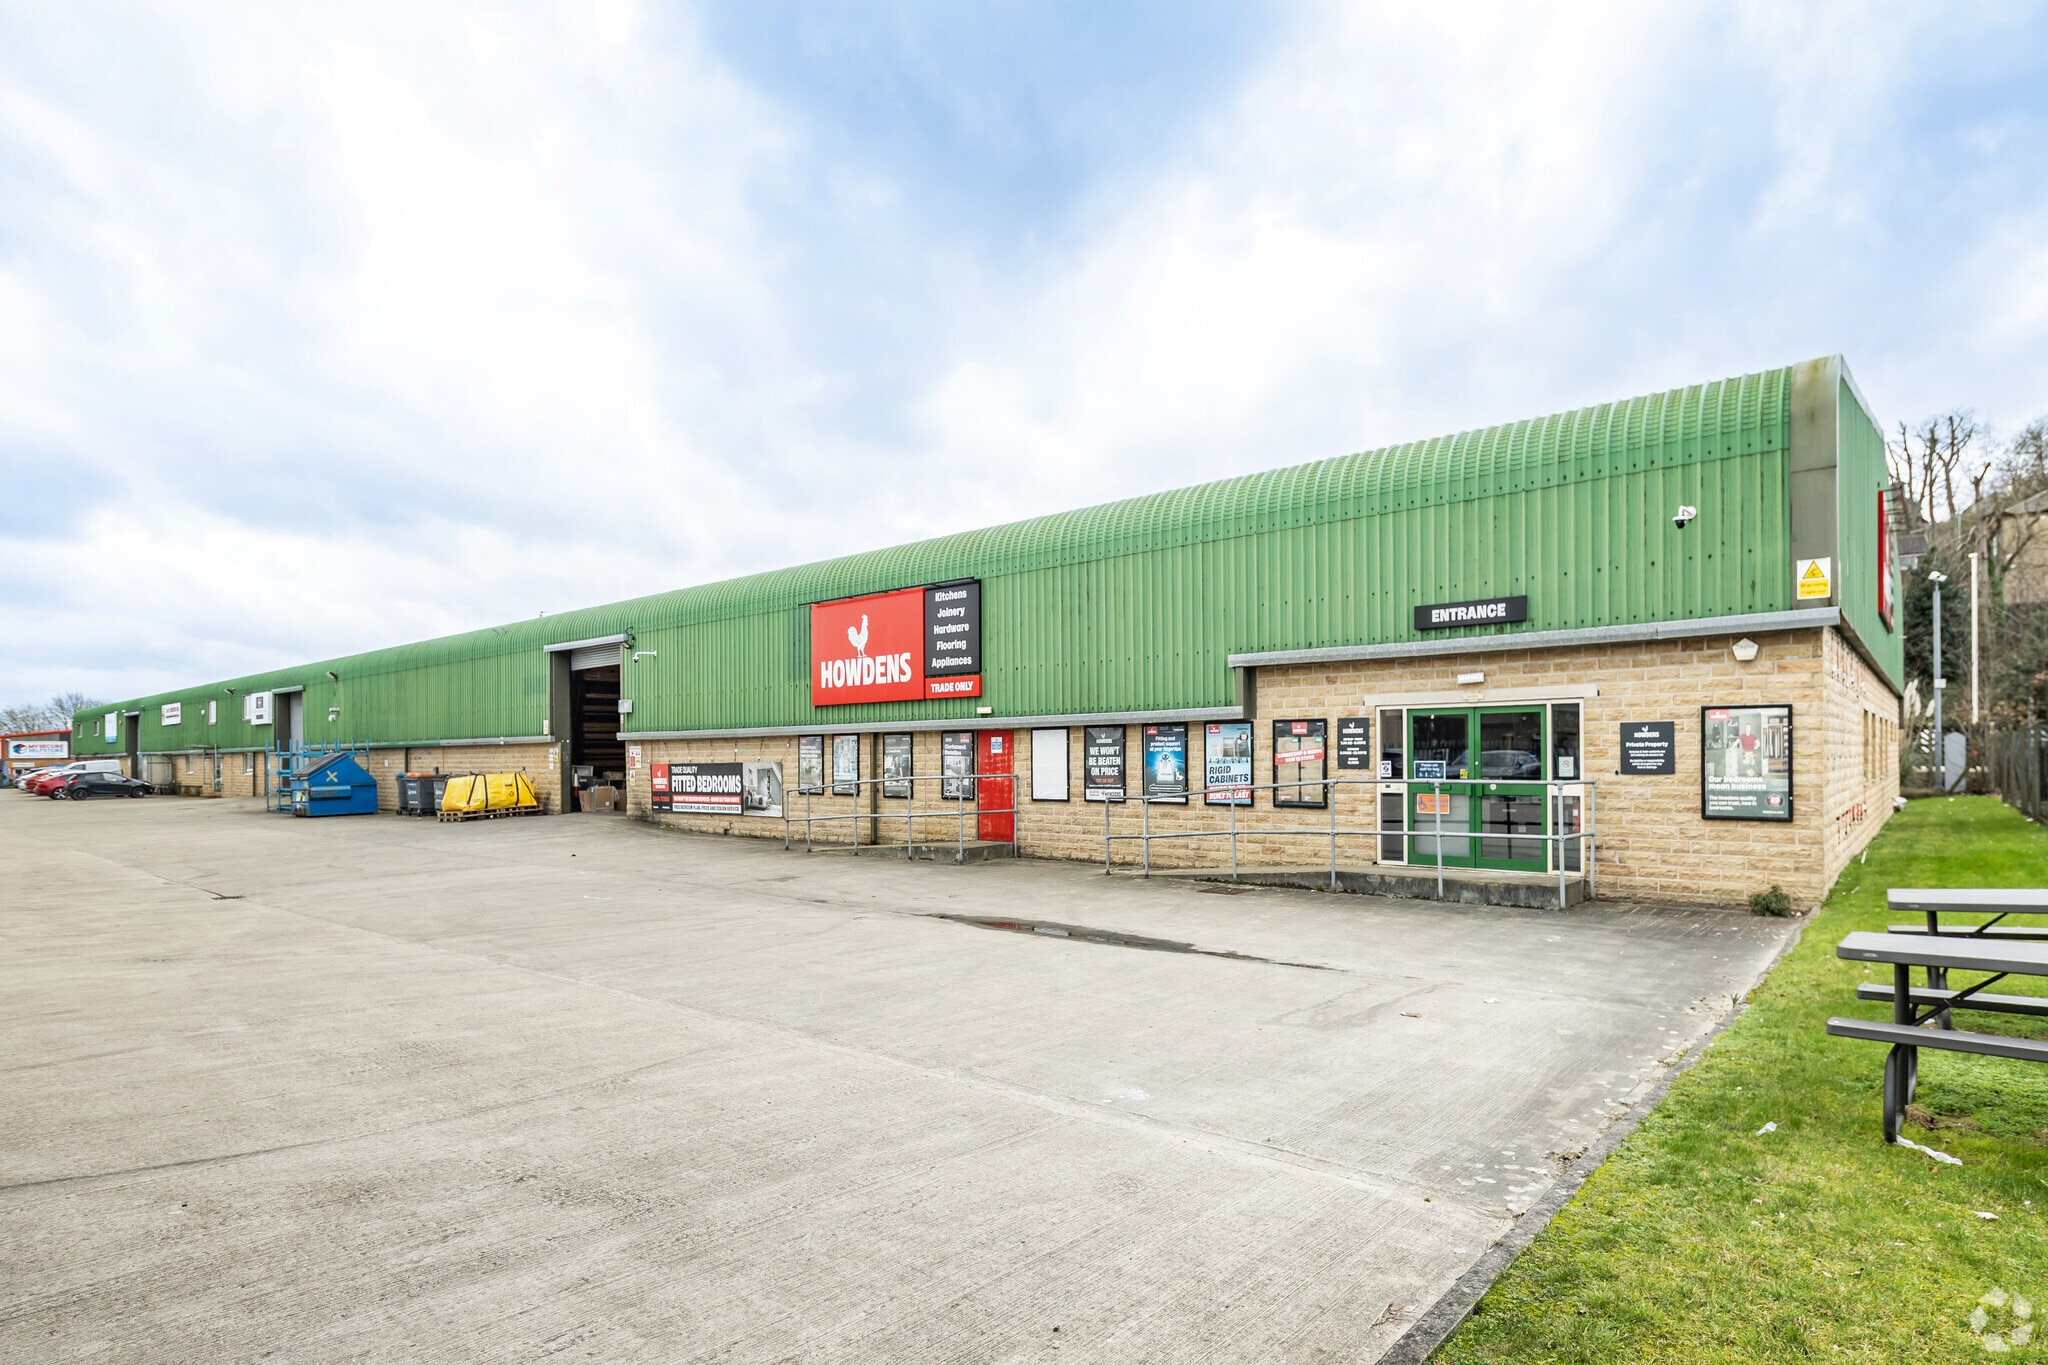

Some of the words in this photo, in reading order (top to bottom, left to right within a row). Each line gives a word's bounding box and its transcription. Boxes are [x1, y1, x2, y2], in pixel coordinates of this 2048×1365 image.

[935, 590, 967, 602] Kitchens
[937, 607, 965, 618] Joinery
[1431, 603, 1507, 623] ENTRANCE
[934, 622, 969, 635] Hardware
[937, 640, 967, 651] Flooring
[932, 656, 972, 669] Appliances
[821, 652, 912, 689] HOWDENS
[931, 682, 954, 693] TRADE
[955, 681, 973, 691] ONLY
[1089, 747, 1099, 755] WE
[1100, 746, 1120, 755] WON'T
[1088, 757, 1097, 766] BE
[1097, 756, 1121, 766] BEATEN
[671, 766, 683, 774] TRADE
[683, 766, 698, 774] QUALITY
[1090, 767, 1100, 776] ON
[1100, 767, 1119, 776] PRICE
[1209, 765, 1231, 775] RIGID
[671, 775, 696, 792] FITTED
[696, 775, 741, 793] BEDROOMS
[1209, 773, 1249, 784] CABINETS
[1209, 792, 1225, 800] BUILT
[1234, 791, 1250, 799] LAST
